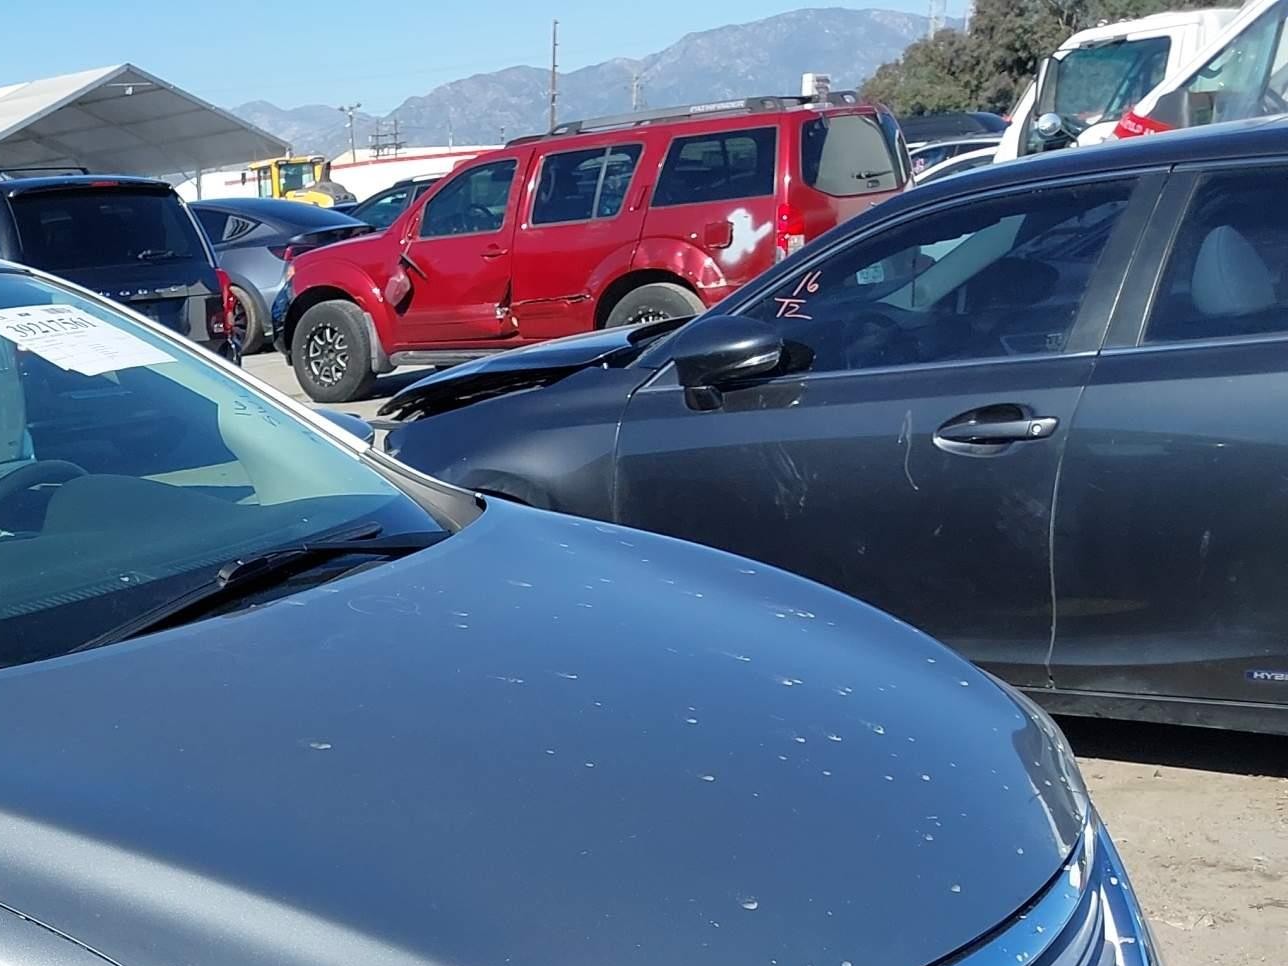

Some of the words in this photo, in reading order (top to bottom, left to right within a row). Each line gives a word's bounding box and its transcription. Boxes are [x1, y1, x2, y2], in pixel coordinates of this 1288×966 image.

[792, 270, 822, 296] 16
[5, 316, 98, 338] 39217561
[1253, 671, 1288, 680] HYB
